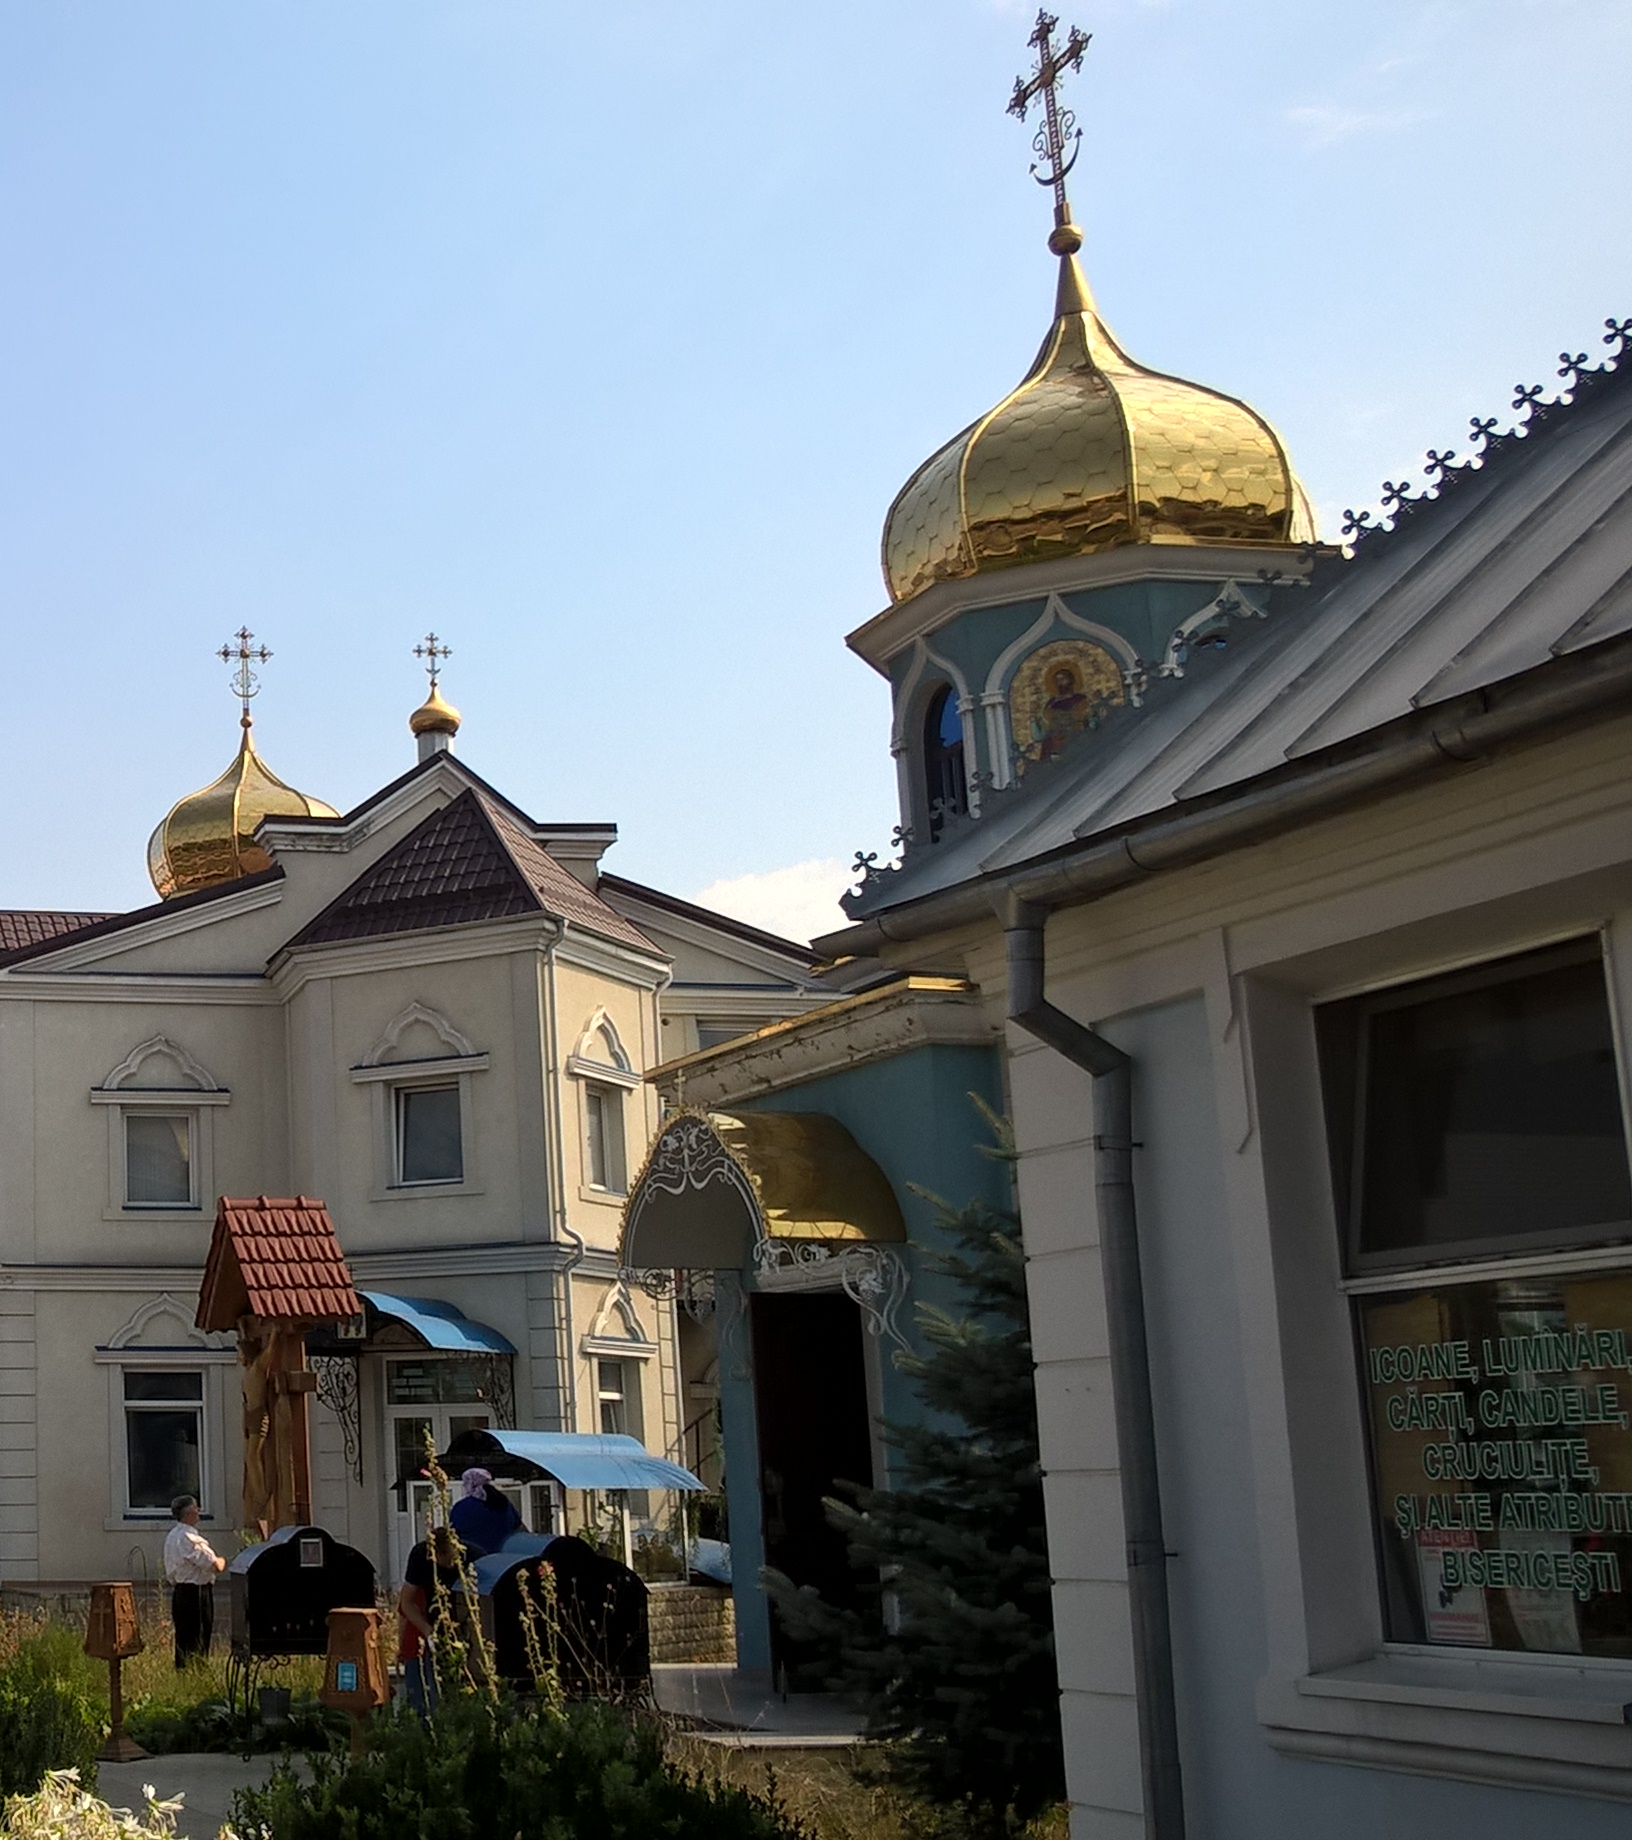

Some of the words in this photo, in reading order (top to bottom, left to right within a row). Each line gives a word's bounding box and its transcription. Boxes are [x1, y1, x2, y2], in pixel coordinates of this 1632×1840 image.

[1369, 1340, 1479, 1384] ICOANE,
[1479, 1384, 1630, 1430] CANDELE,
[1425, 1493, 1494, 1531] ALTE
